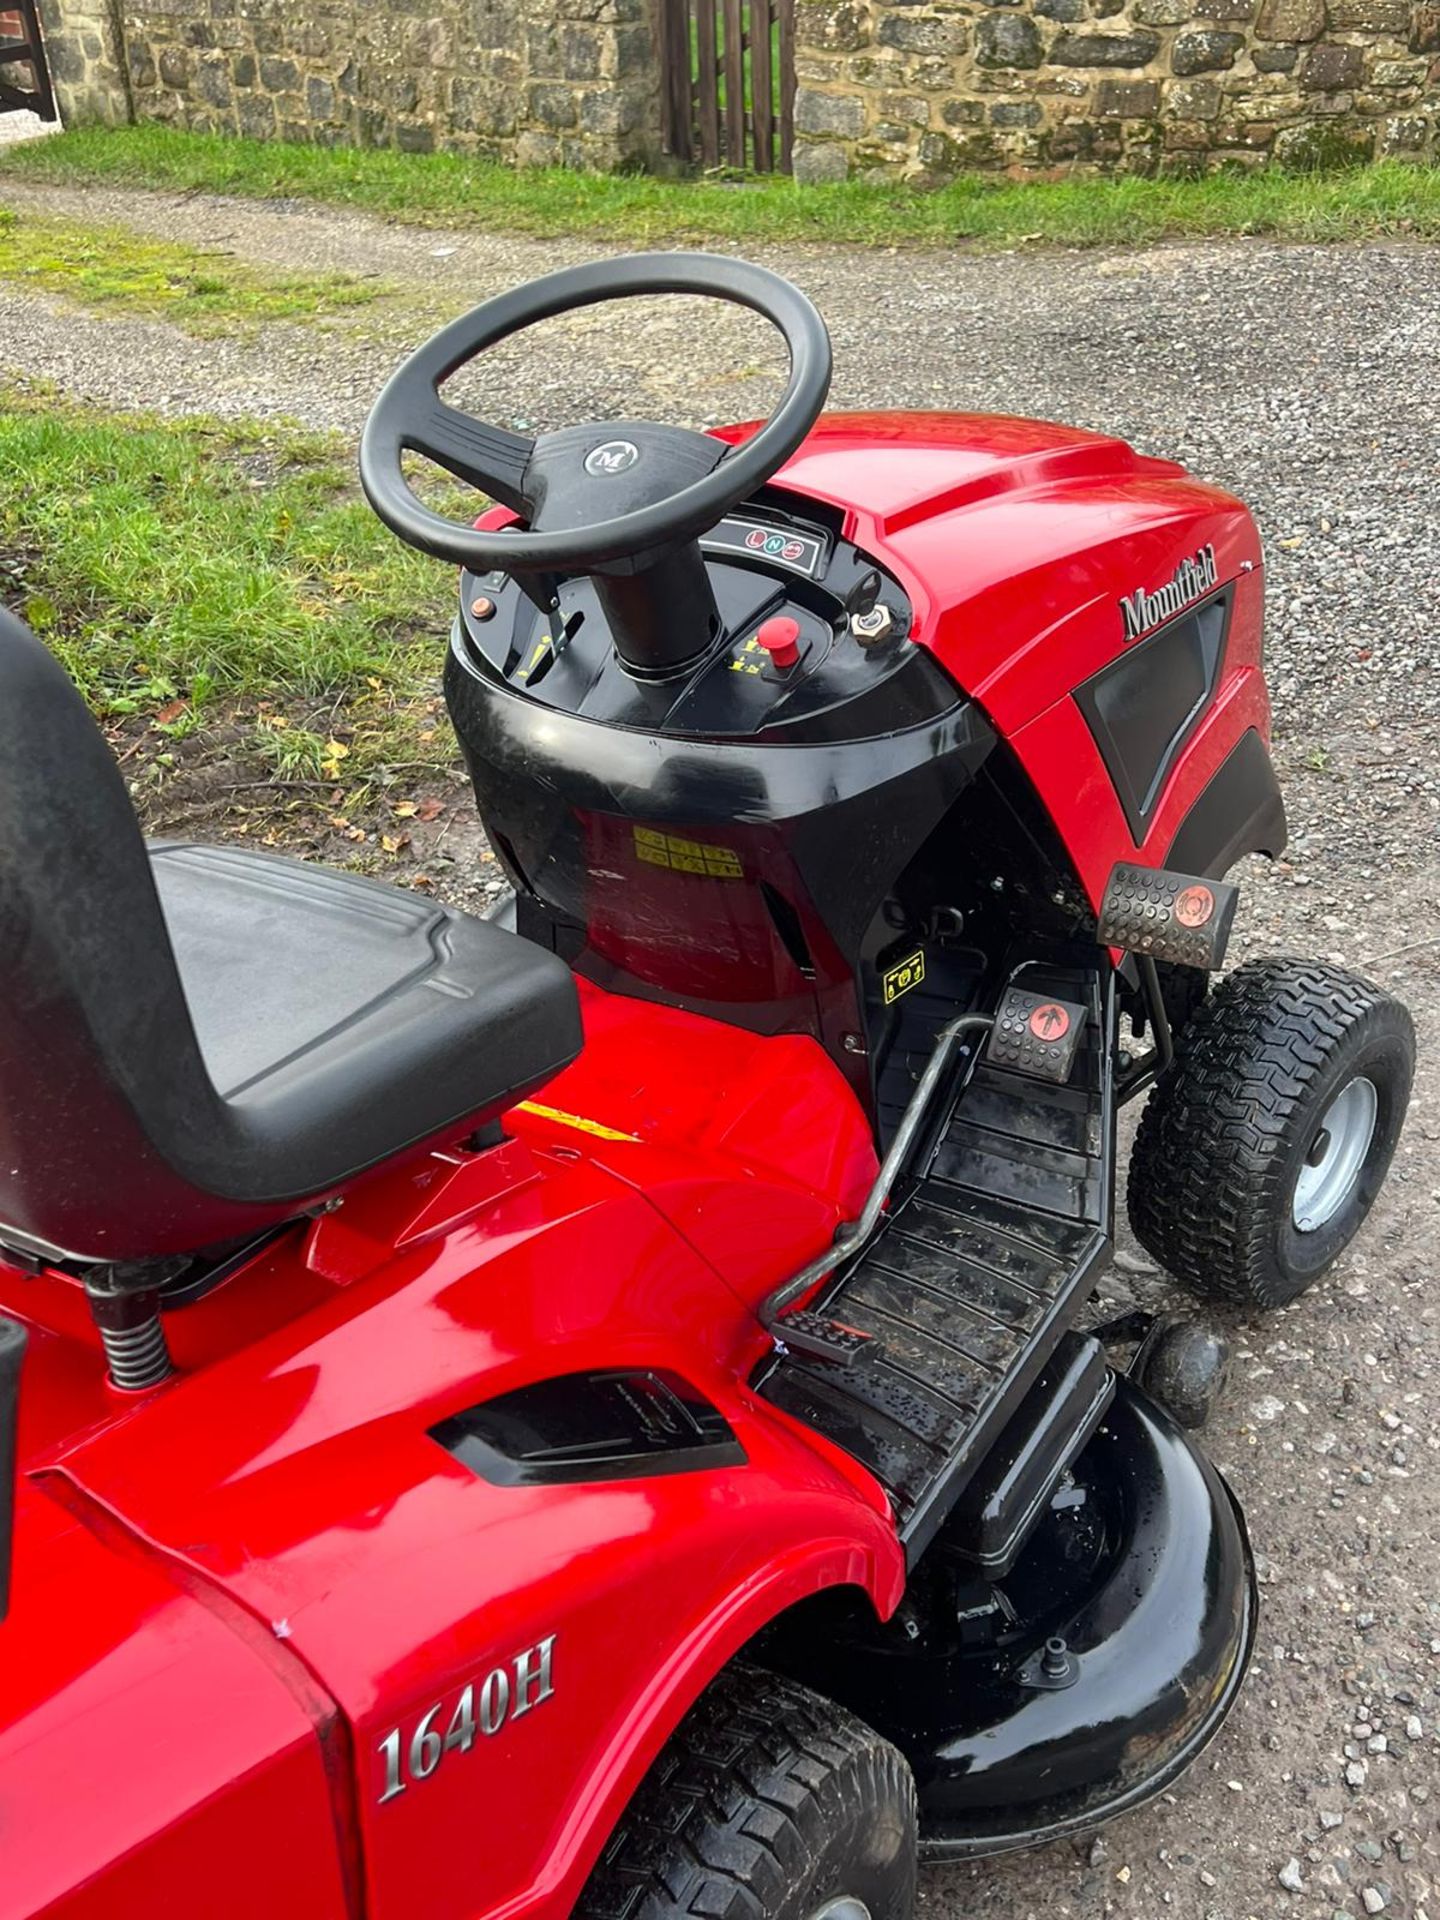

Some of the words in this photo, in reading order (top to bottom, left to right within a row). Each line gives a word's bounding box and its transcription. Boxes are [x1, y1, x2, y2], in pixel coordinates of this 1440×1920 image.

[595, 450, 625, 468] M
[769, 538, 781, 548] N
[1119, 543, 1219, 641] Mountfield
[376, 1632, 557, 1804] 1640H
